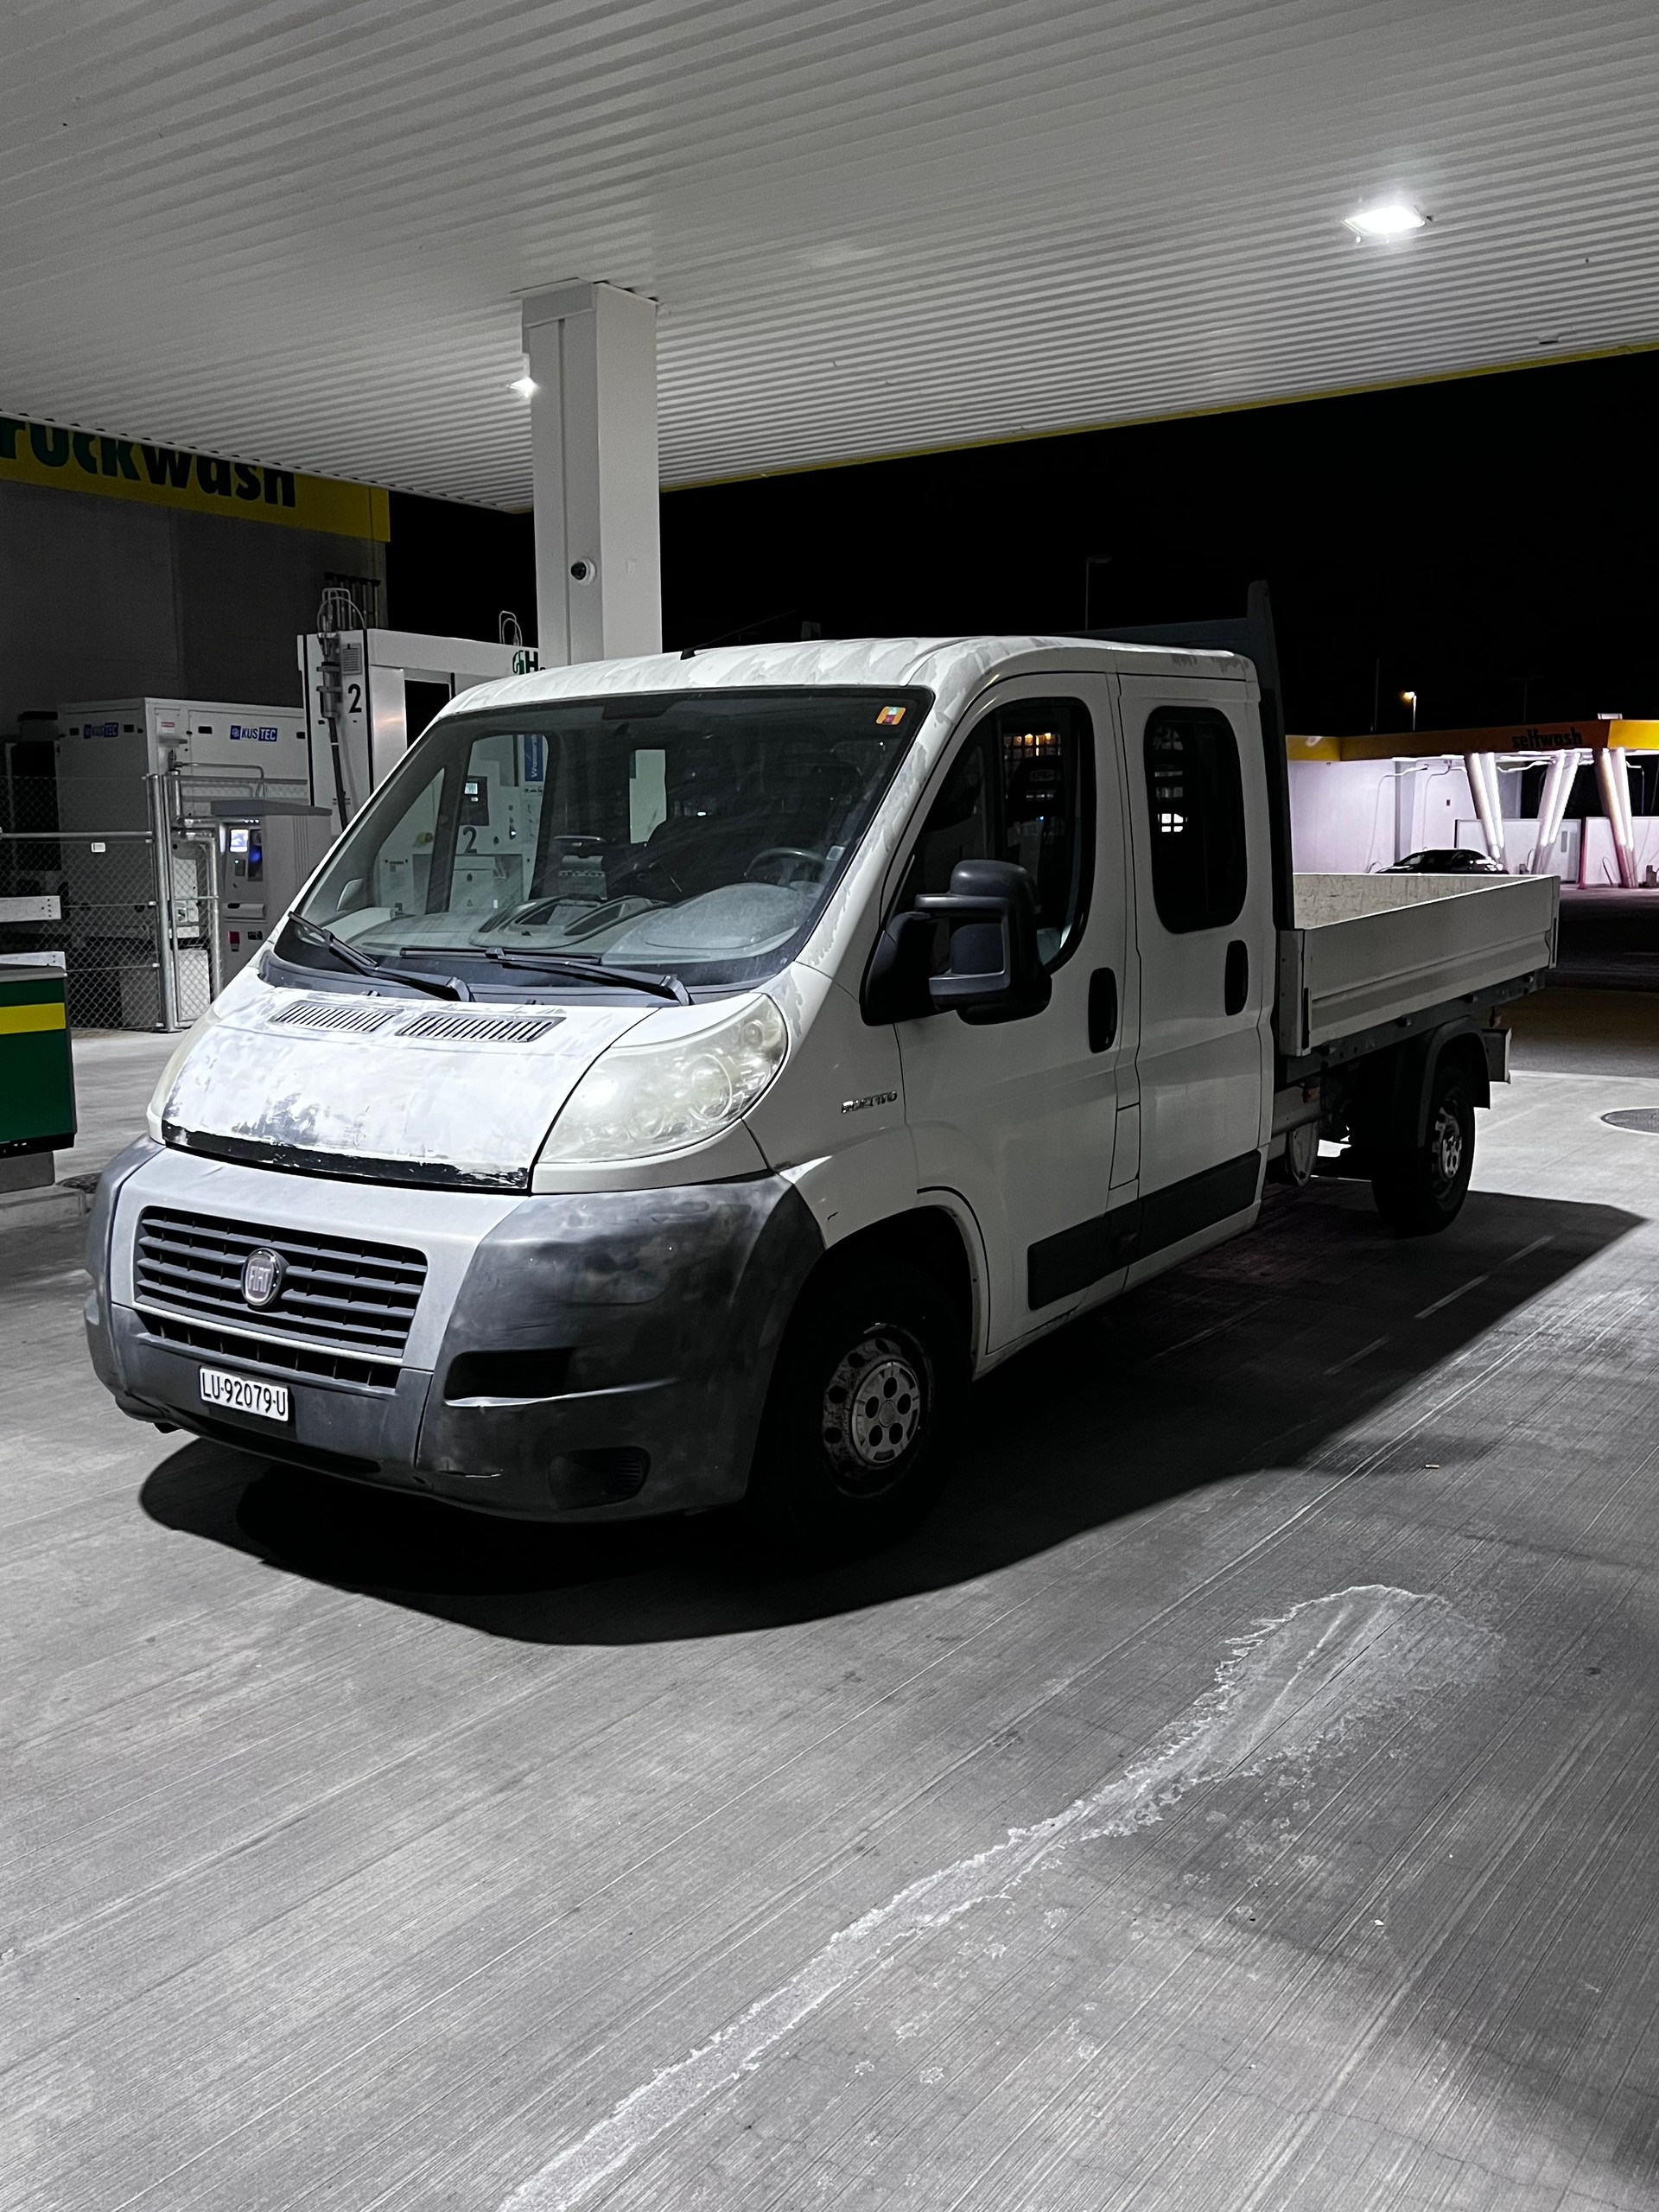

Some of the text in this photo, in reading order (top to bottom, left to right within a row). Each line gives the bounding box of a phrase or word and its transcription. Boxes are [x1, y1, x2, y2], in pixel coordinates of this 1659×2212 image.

[347, 683, 362, 714] 2
[1511, 727, 1583, 748] selfwash
[462, 826, 478, 855] 2
[248, 1266, 271, 1293] FIAT
